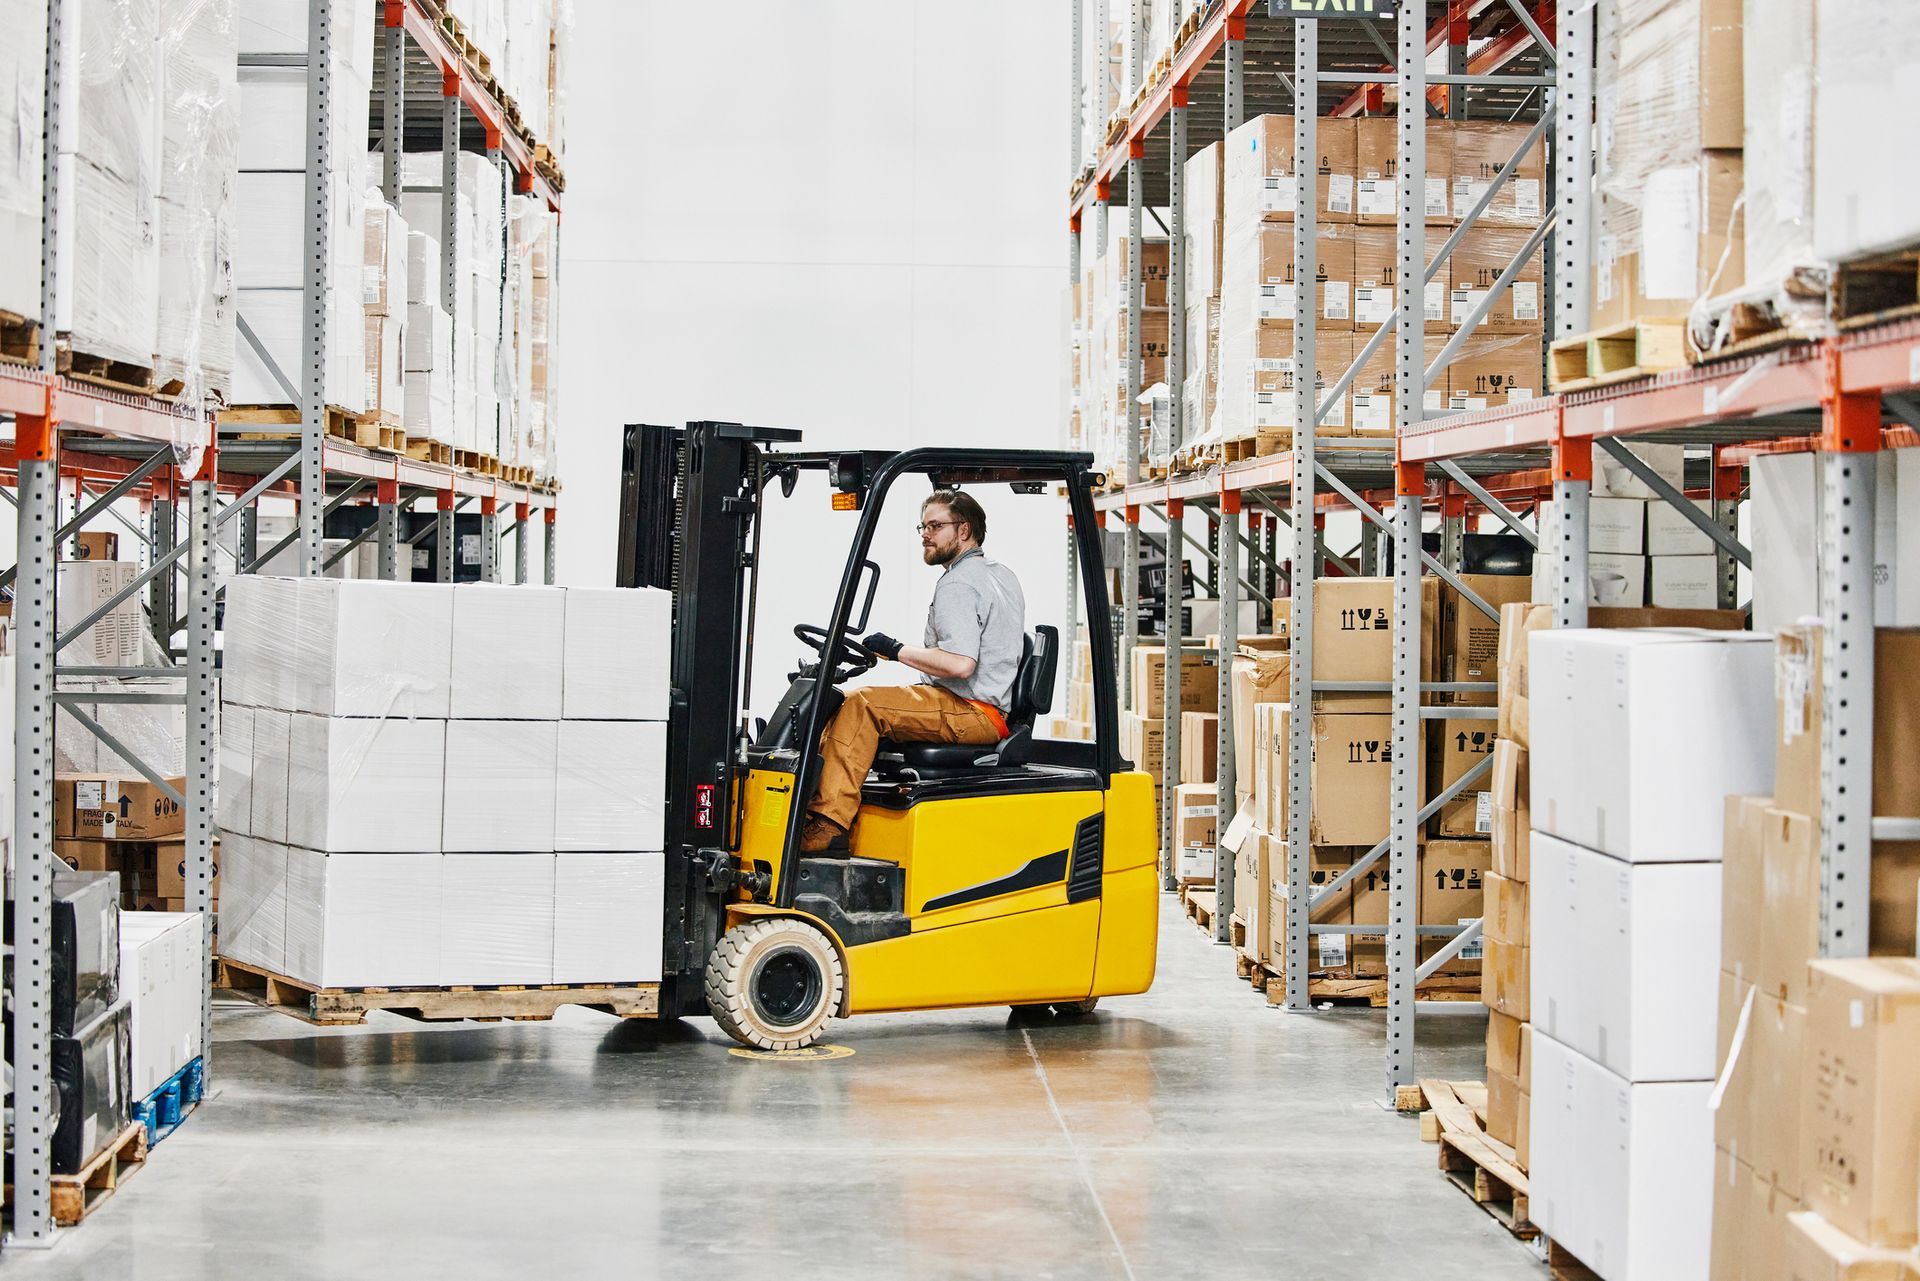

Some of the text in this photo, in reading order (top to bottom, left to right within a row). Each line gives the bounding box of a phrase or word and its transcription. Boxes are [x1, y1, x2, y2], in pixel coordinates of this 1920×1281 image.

[1322, 156, 1328, 166] 6
[1319, 264, 1324, 274] 6
[1316, 370, 1322, 380] 6
[1508, 375, 1514, 386] 6
[1377, 608, 1385, 619] 5
[1384, 740, 1392, 752] 5
[82, 818, 104, 826] MADE
[1331, 871, 1339, 881] 5
[1470, 868, 1478, 879] 5
